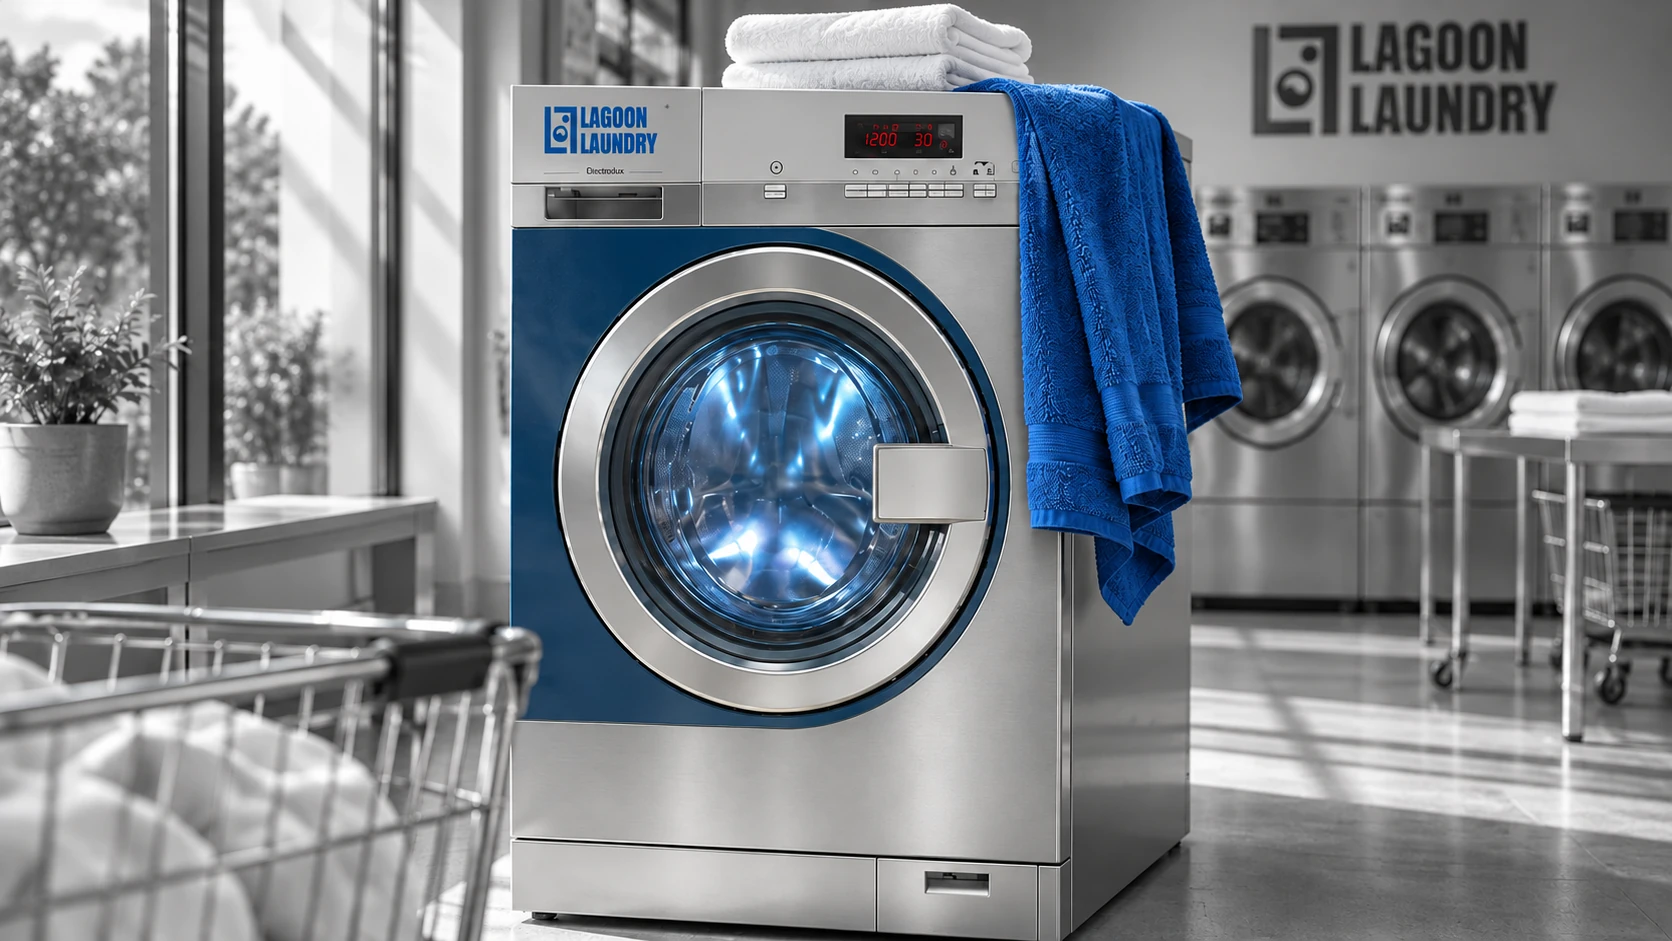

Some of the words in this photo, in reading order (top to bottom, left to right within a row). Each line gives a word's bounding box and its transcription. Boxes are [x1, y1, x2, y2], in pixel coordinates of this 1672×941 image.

[1350, 19, 1528, 74] LAGOON
[580, 106, 648, 129] LAGOON
[1350, 81, 1557, 135] LAUNDRY
[580, 132, 658, 154] LAUNDRY
[865, 132, 897, 147] 1200
[914, 132, 933, 147] 30
